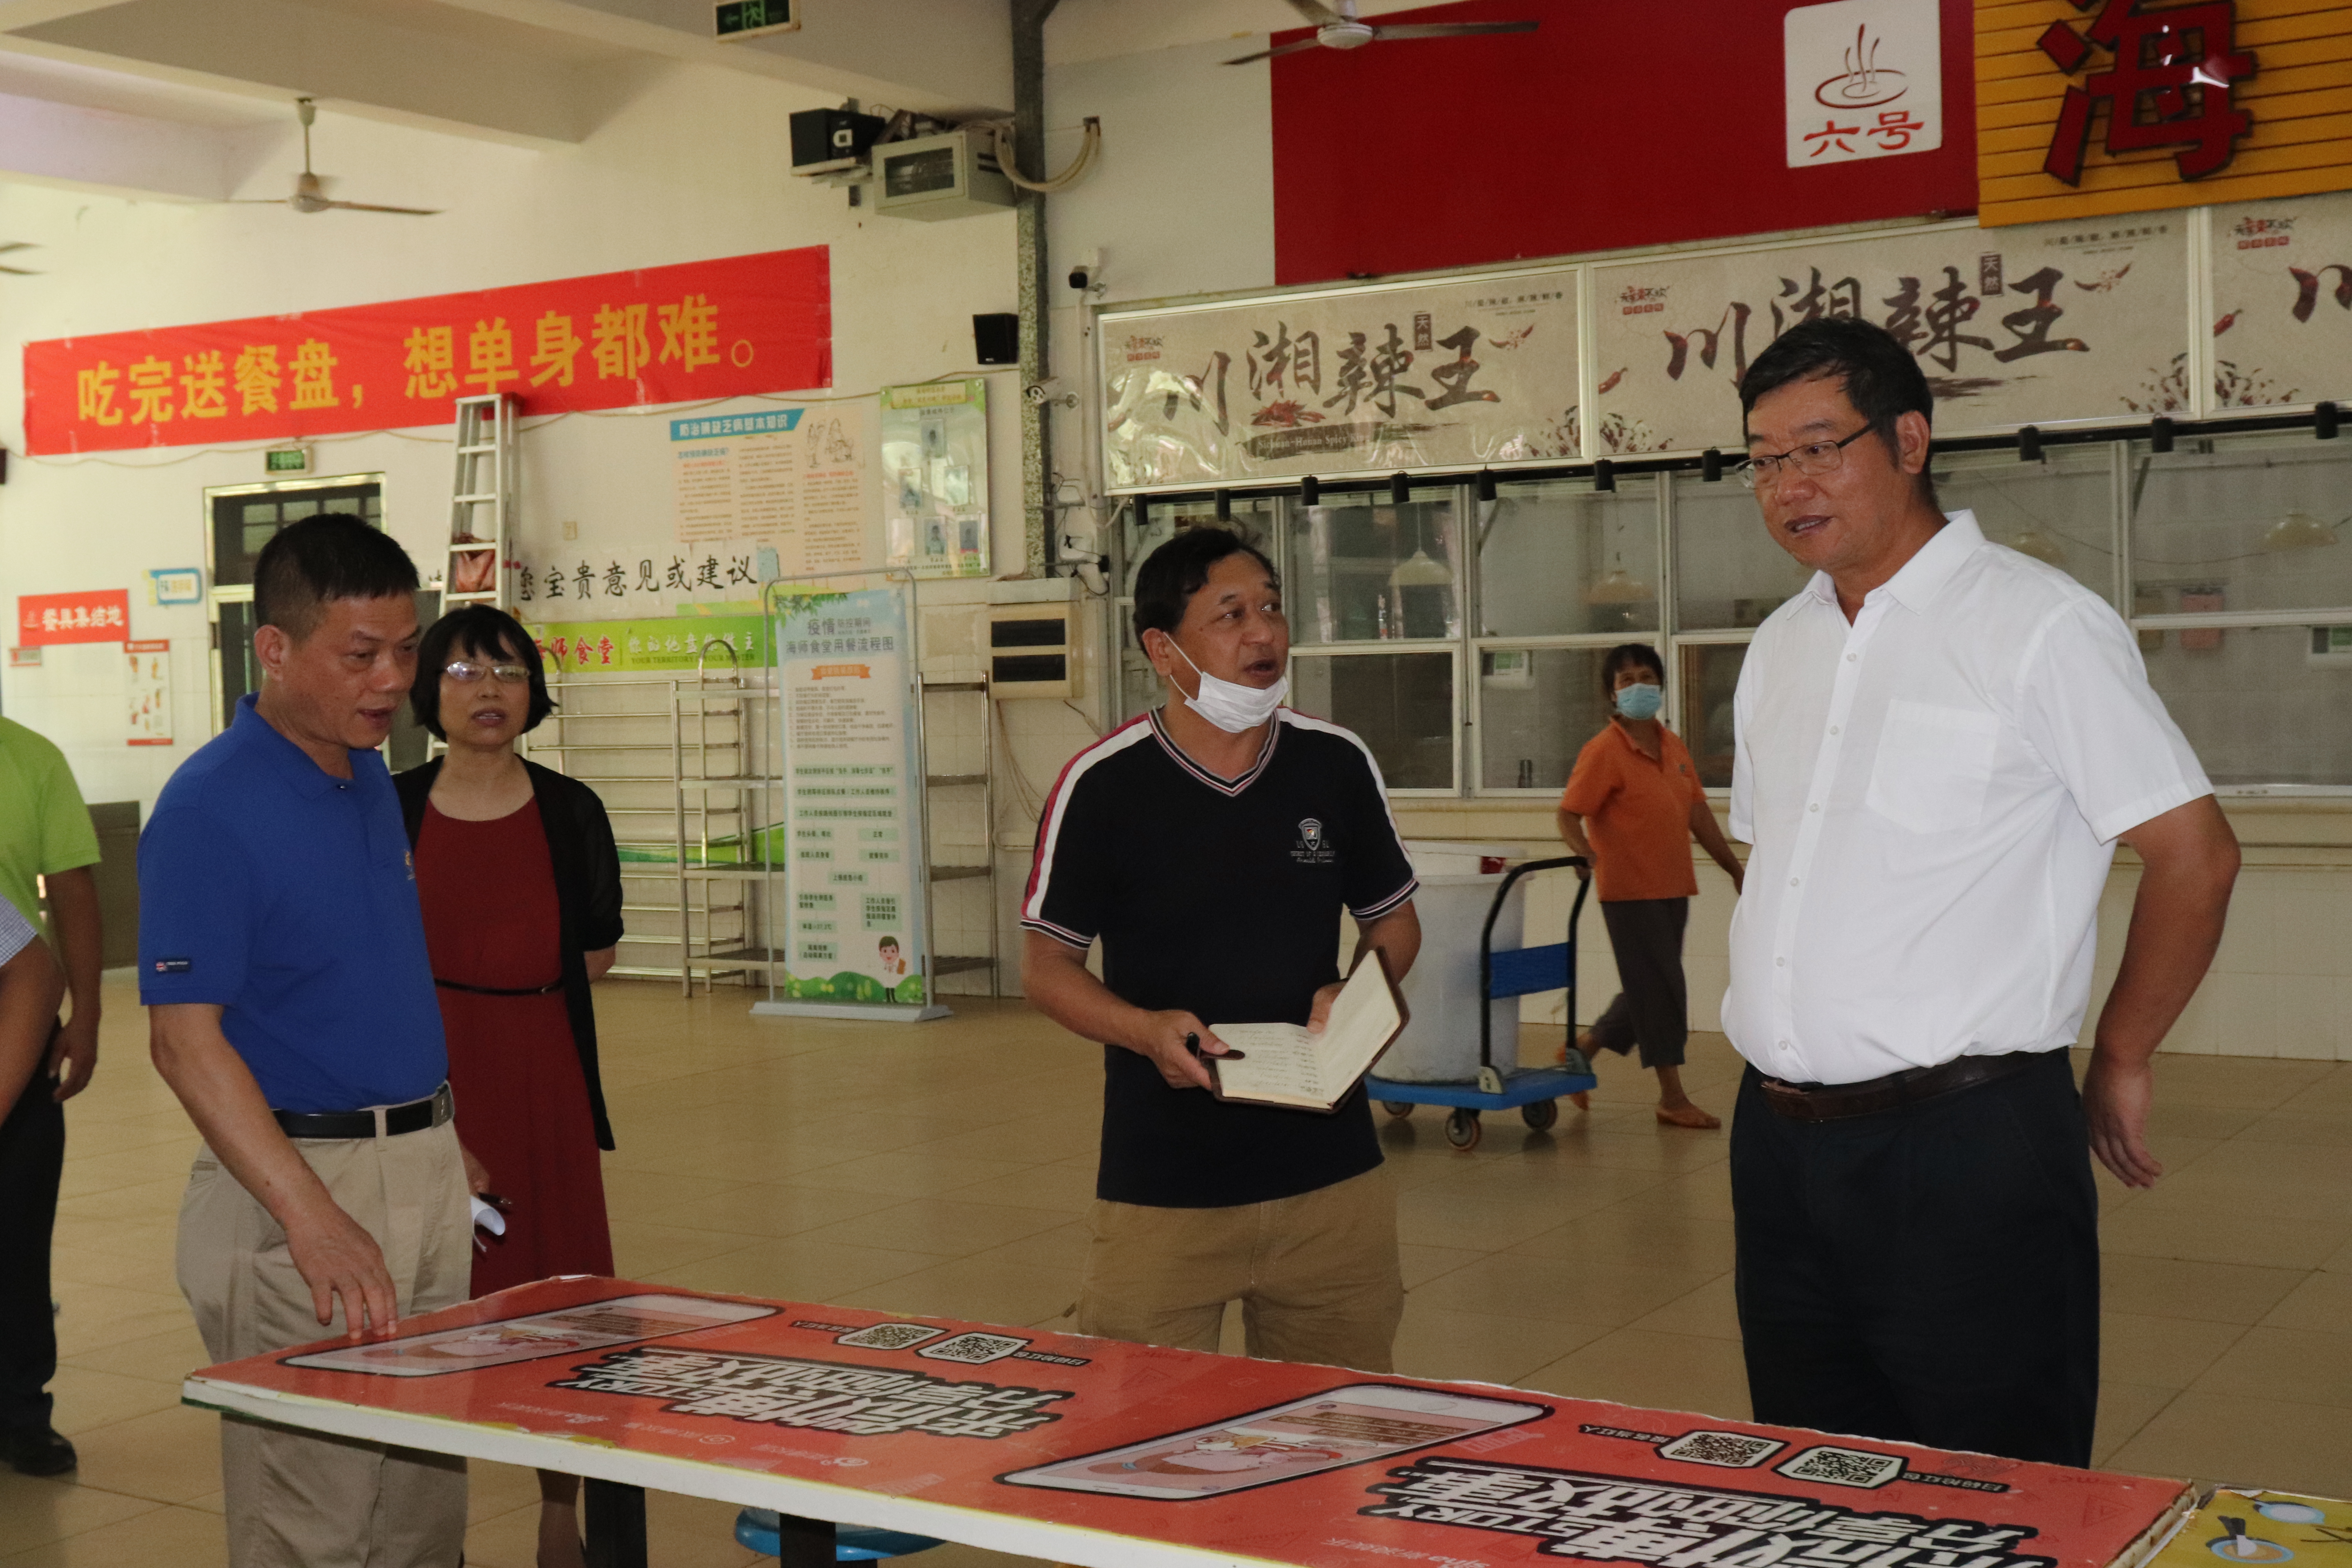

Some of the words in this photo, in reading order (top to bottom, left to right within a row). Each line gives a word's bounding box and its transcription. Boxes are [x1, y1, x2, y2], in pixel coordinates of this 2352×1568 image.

[1804, 110, 1924, 157] 六号
[1984, 256, 2000, 294] 天然
[1416, 316, 1431, 349] 天然
[1163, 321, 1501, 436] 川湘辣王
[1325, 435, 1347, 446] Spicy
[808, 618, 835, 635] 疫情
[786, 636, 893, 654] 海师食堂用餐流程图
[555, 1379, 725, 1400] STORY
[1368, 1502, 1594, 1537] STORY
